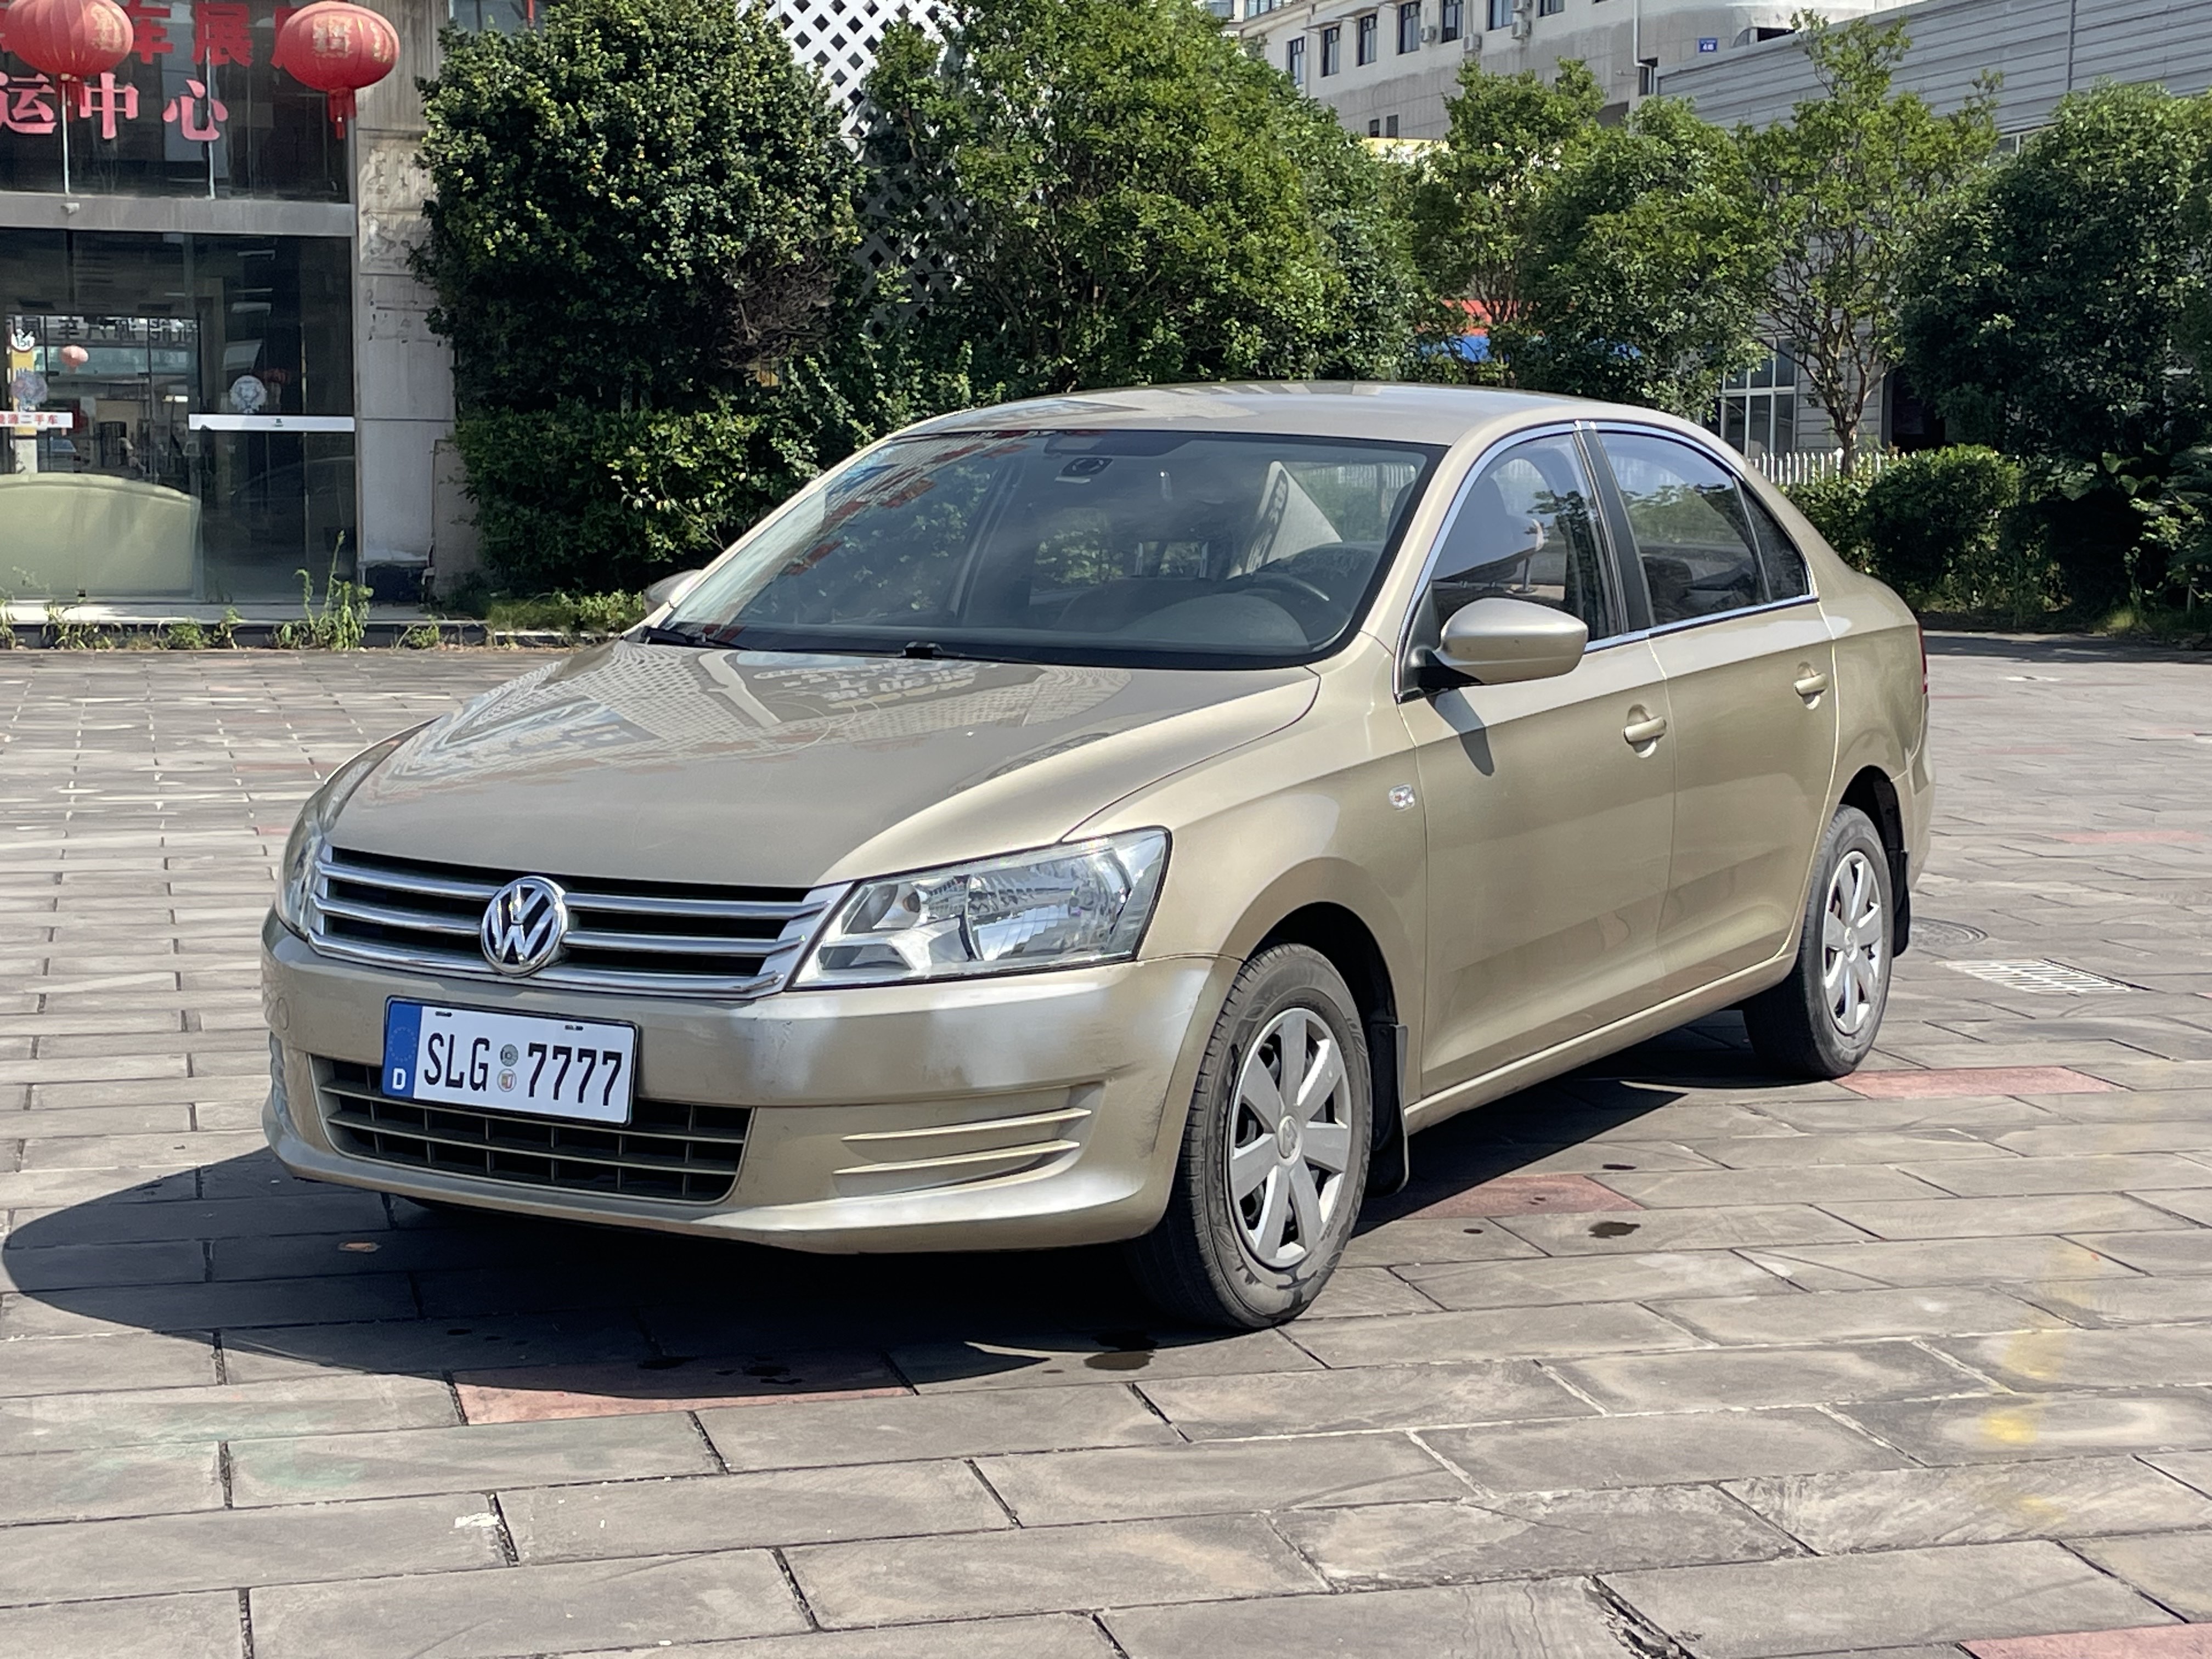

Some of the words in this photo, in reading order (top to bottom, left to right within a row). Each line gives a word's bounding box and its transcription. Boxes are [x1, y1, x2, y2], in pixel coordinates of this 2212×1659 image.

[0, 414, 58, 425] 二手车
[392, 1068, 407, 1090] D
[424, 1032, 490, 1092] SLG
[528, 1042, 622, 1106] 7777
